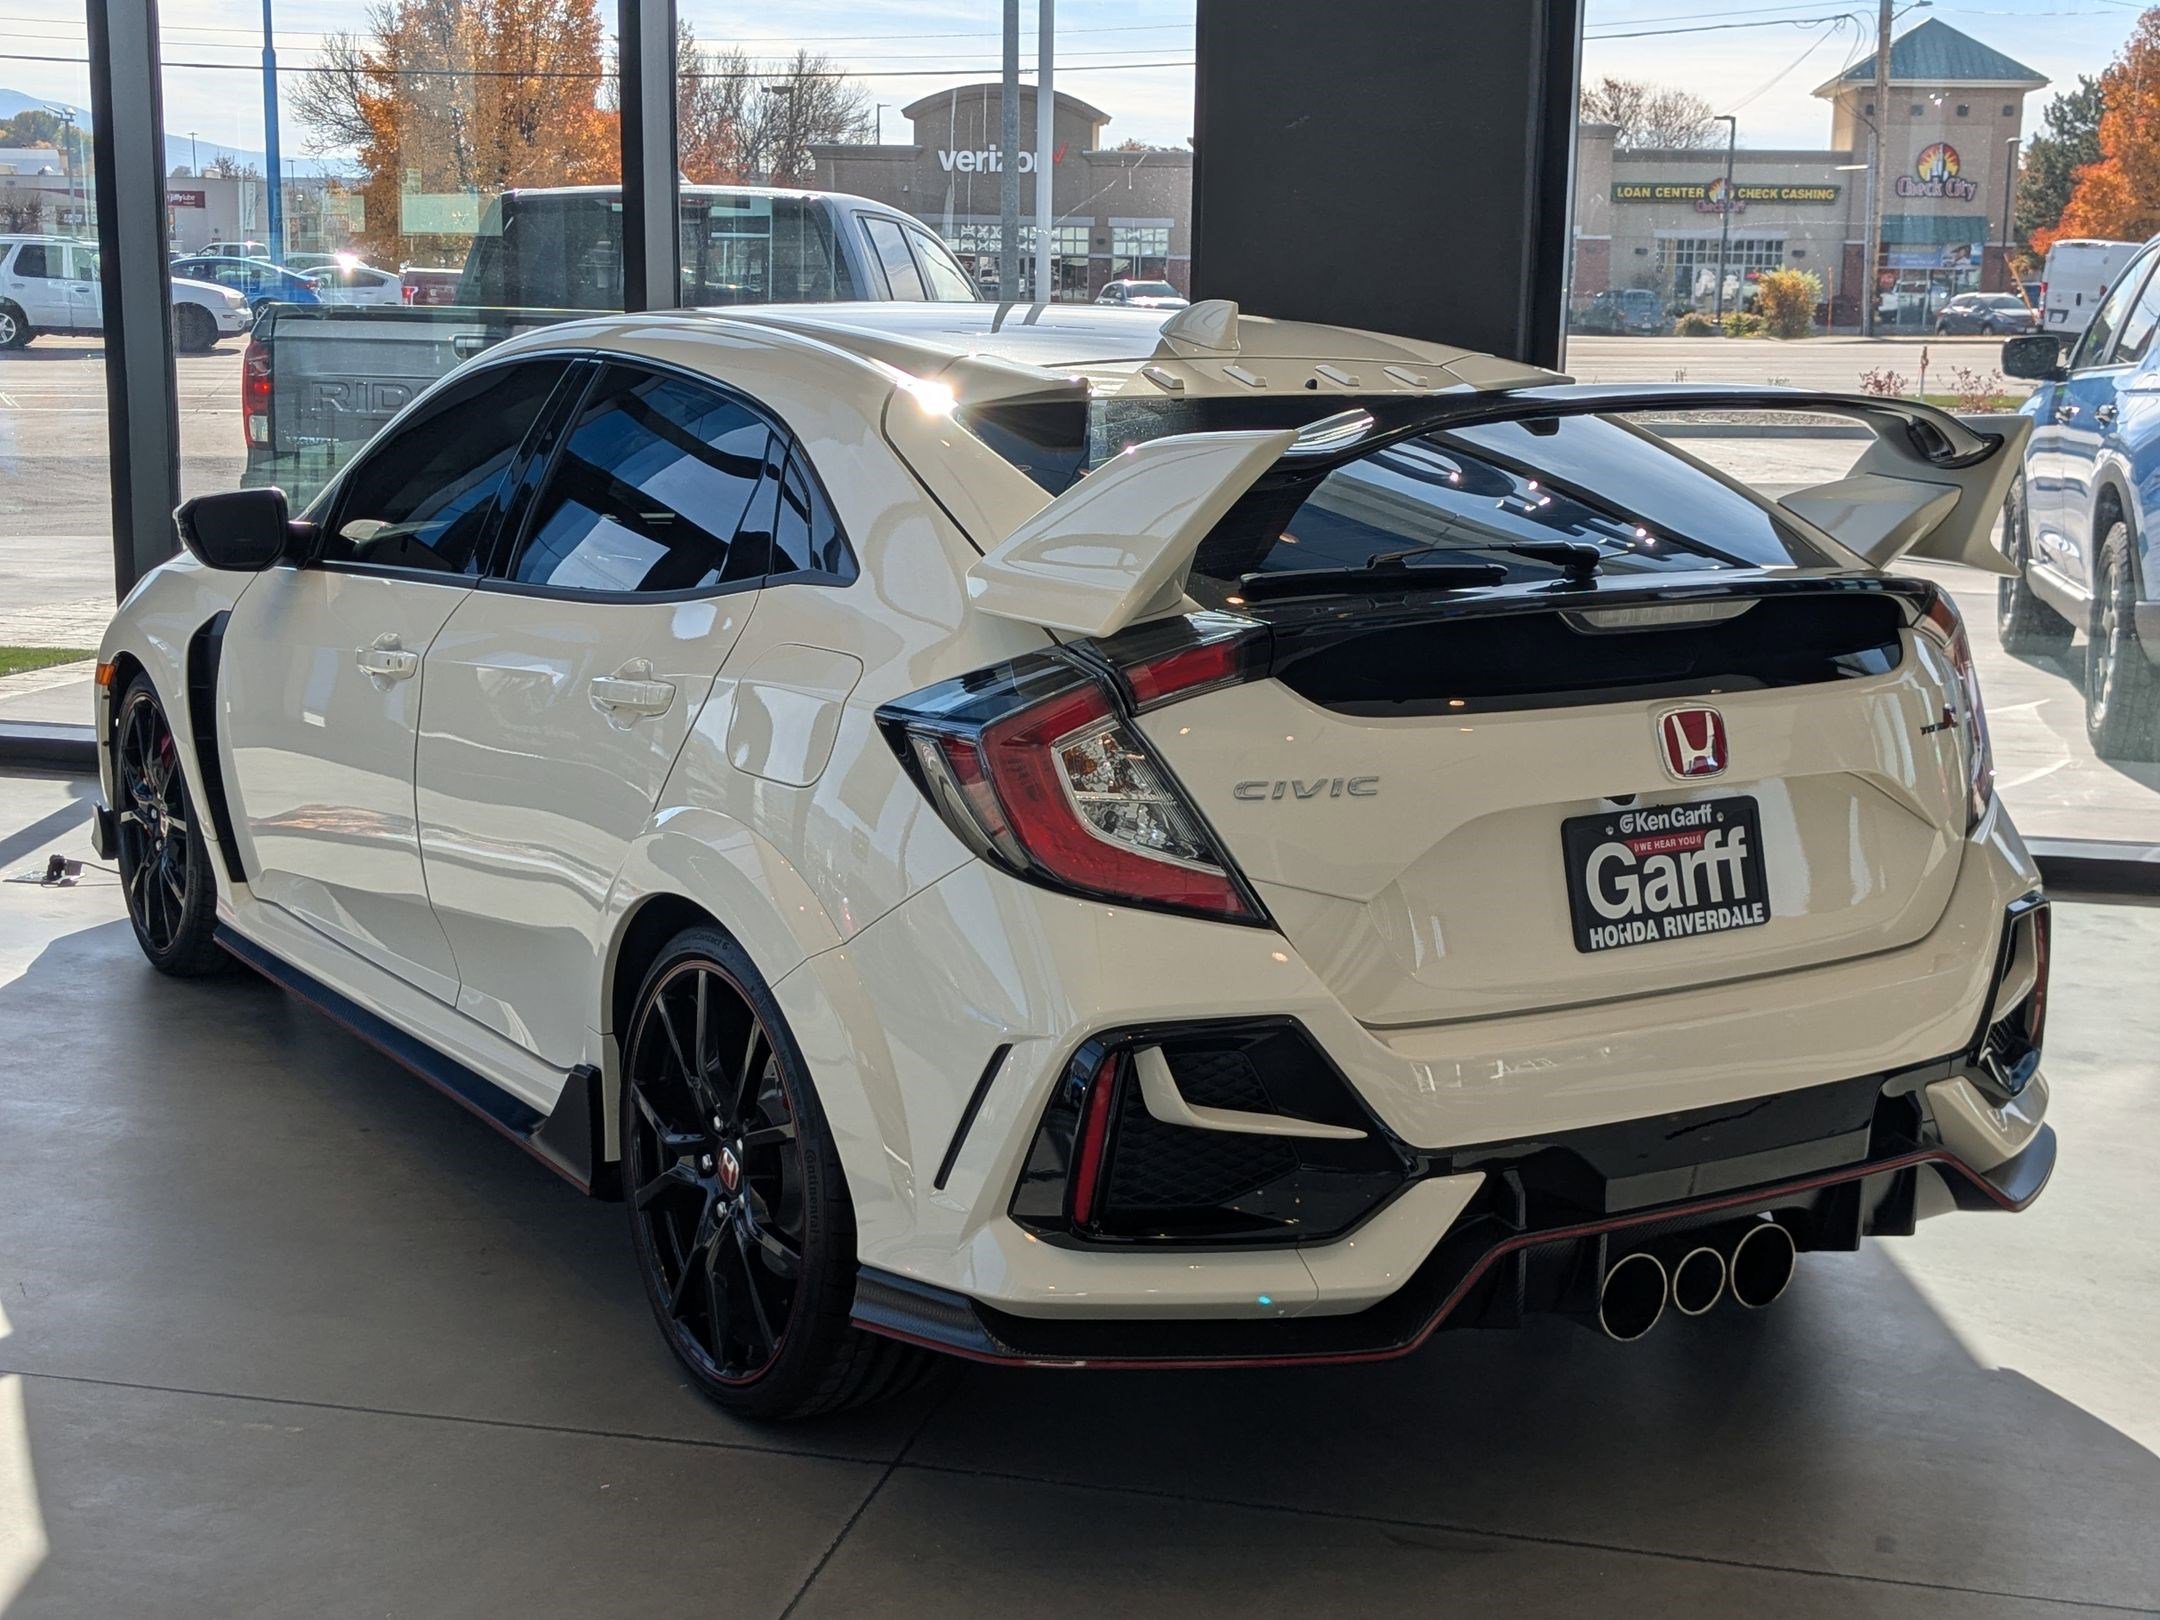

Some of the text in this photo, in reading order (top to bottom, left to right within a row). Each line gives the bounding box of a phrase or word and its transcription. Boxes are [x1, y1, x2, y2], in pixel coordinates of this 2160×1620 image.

[1617, 187, 1835, 200] LOAN CENTER CHECK CASHING
[1896, 177, 1977, 202] Check City
[312, 381, 420, 414] RID
[1233, 776, 1379, 800] CIVIC
[1635, 804, 1713, 832] Ken Garff
[1639, 836, 1695, 852] WE HEAR YOU
[1586, 826, 1748, 919] Garff
[1589, 902, 1765, 949] HONDA RIVERDALE
[803, 1149, 820, 1233] Continental
